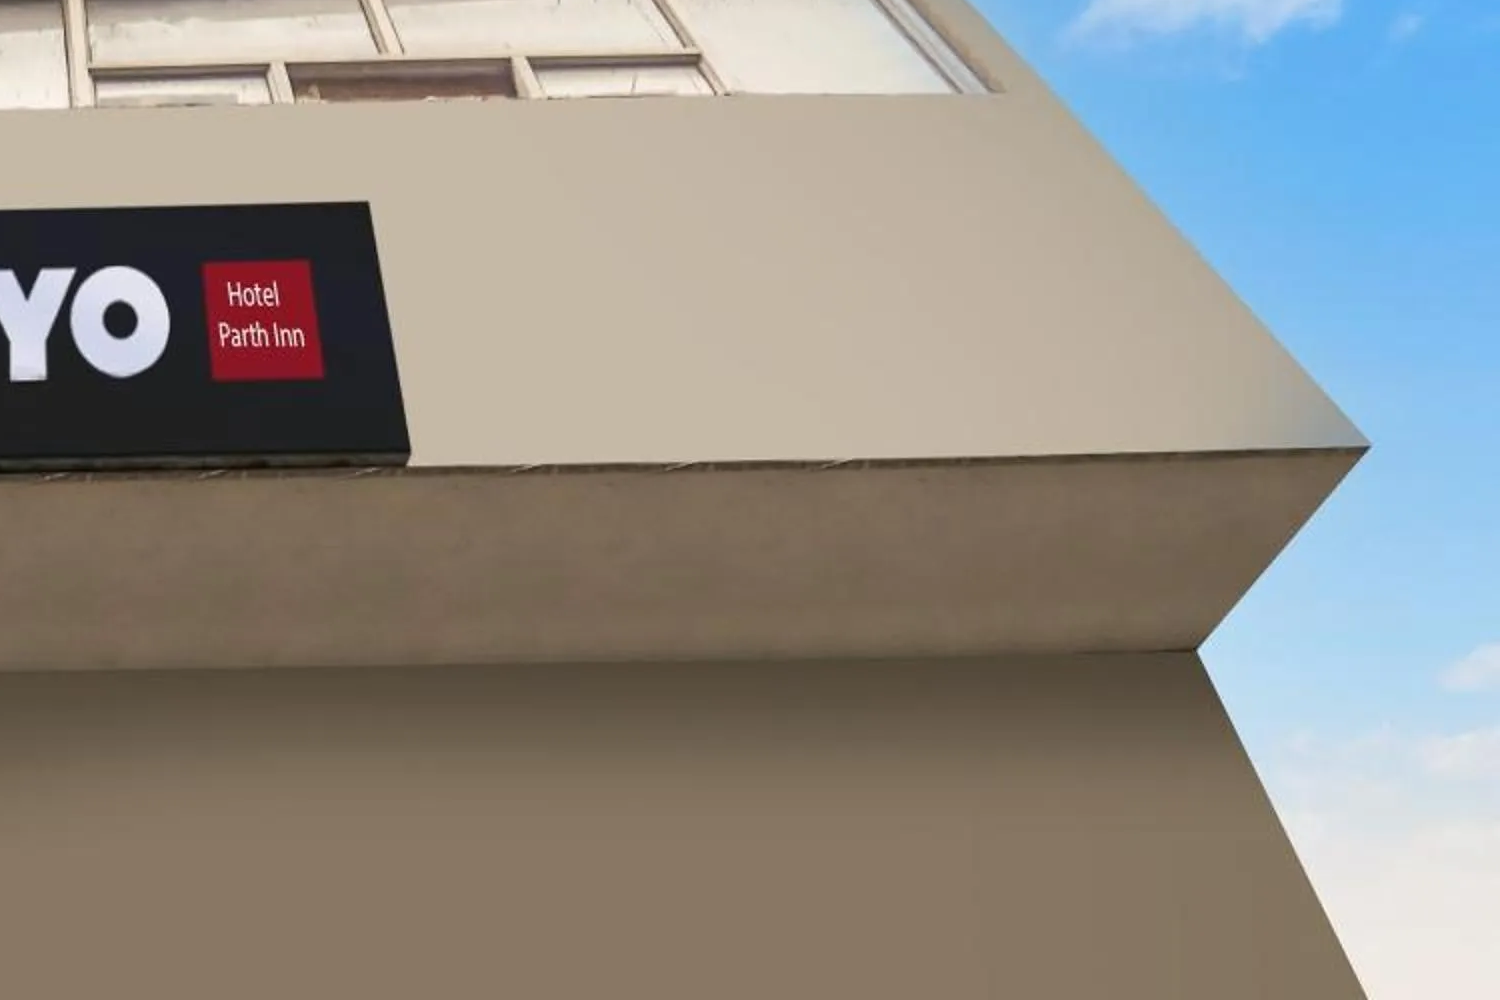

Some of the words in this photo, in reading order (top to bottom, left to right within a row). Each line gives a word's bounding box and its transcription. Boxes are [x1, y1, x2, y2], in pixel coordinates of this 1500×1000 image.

[227, 280, 280, 307] Hotel
[218, 321, 270, 348] Parth
[272, 321, 305, 348] Inn
